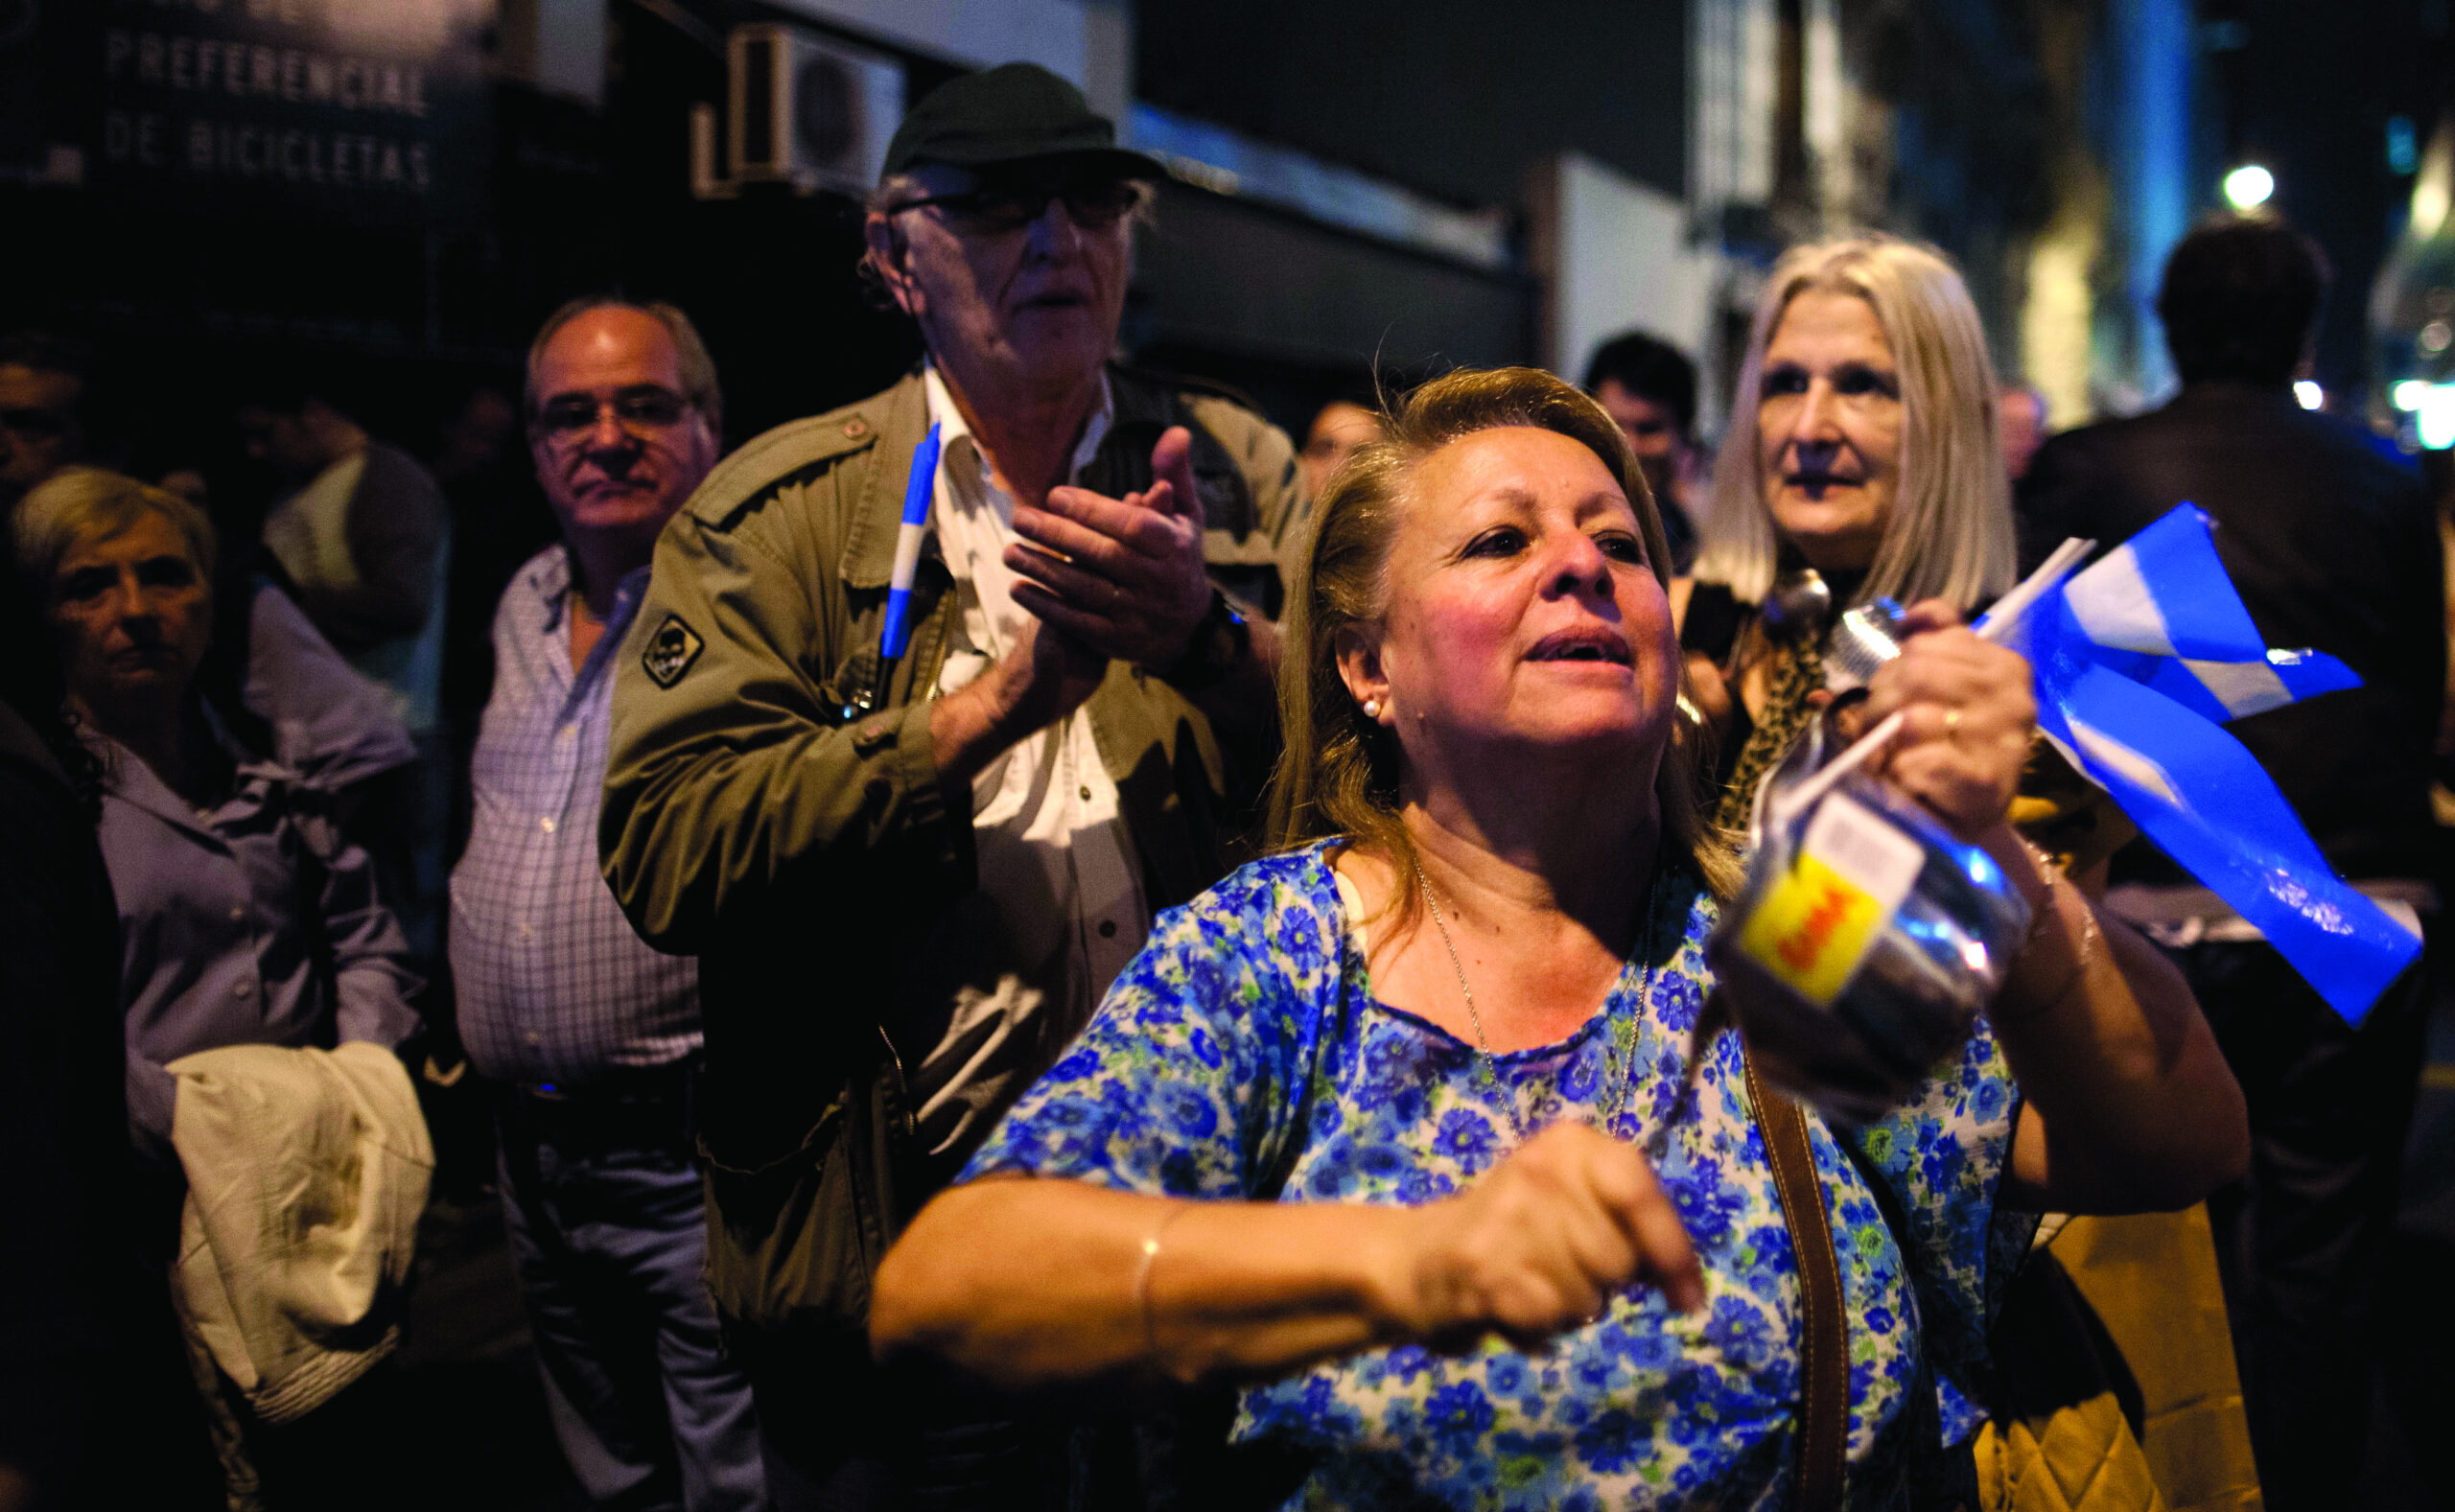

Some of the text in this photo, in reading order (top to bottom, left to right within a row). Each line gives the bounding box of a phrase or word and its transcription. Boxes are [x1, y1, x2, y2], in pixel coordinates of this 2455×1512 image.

[105, 28, 430, 116] PREFERENCIAL
[104, 108, 432, 195] DE BICICLETAS
